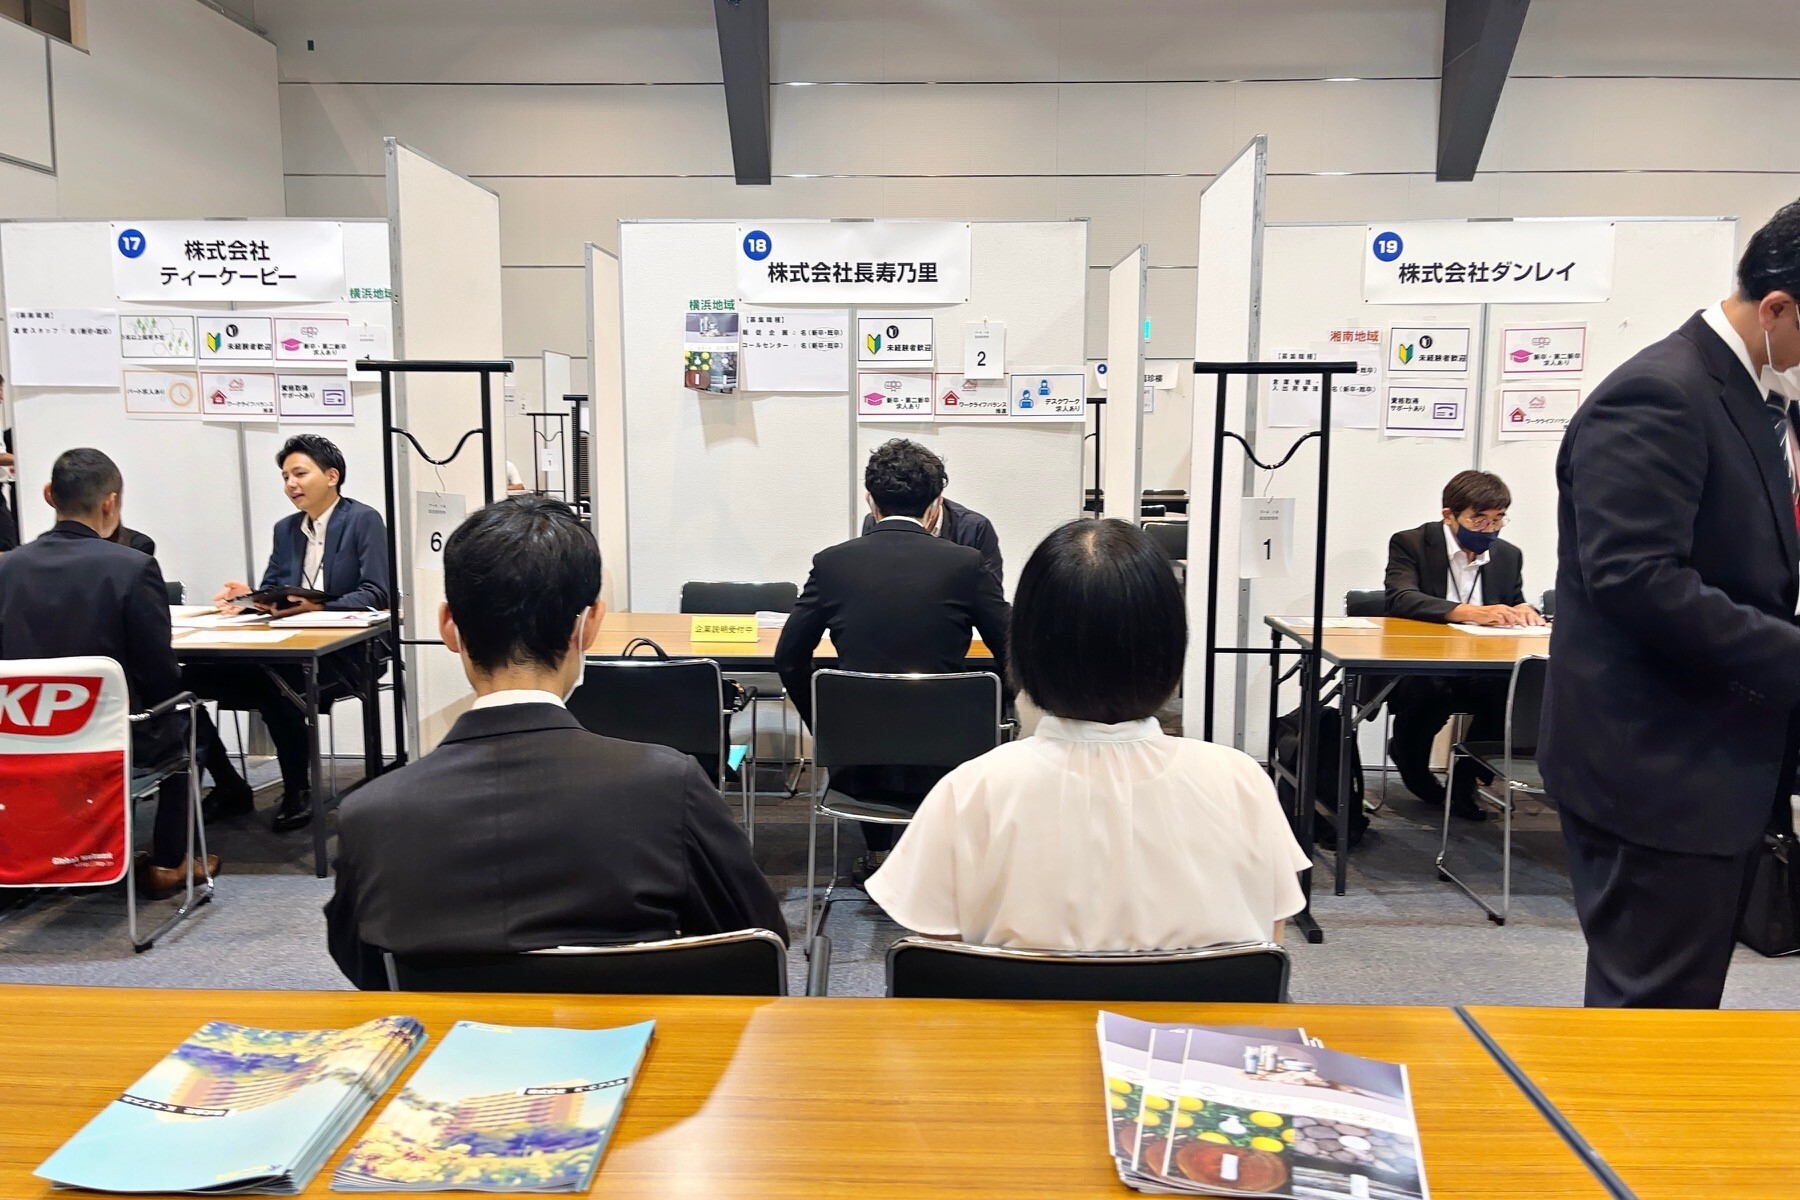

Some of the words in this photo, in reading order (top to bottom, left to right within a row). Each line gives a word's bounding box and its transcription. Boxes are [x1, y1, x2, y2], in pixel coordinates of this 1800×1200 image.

[122, 236, 141, 252] 17
[184, 239, 270, 262] 株式会社
[748, 238, 767, 253] 18
[1378, 239, 1398, 255] 19
[160, 266, 298, 287] ティーケーピー
[767, 261, 939, 284] 株式会社長寿乃里
[1398, 261, 1577, 284] 株式会社ダンレイ
[689, 298, 736, 311] 横浜地域
[1329, 330, 1380, 342] 湘南地域
[886, 344, 932, 352] 未経験者歓迎
[977, 350, 987, 367] 2
[1418, 354, 1467, 363] 未経験者歓迎
[1055, 405, 1080, 413] 求人あり
[430, 531, 443, 552] 6
[1262, 538, 1272, 560] 1
